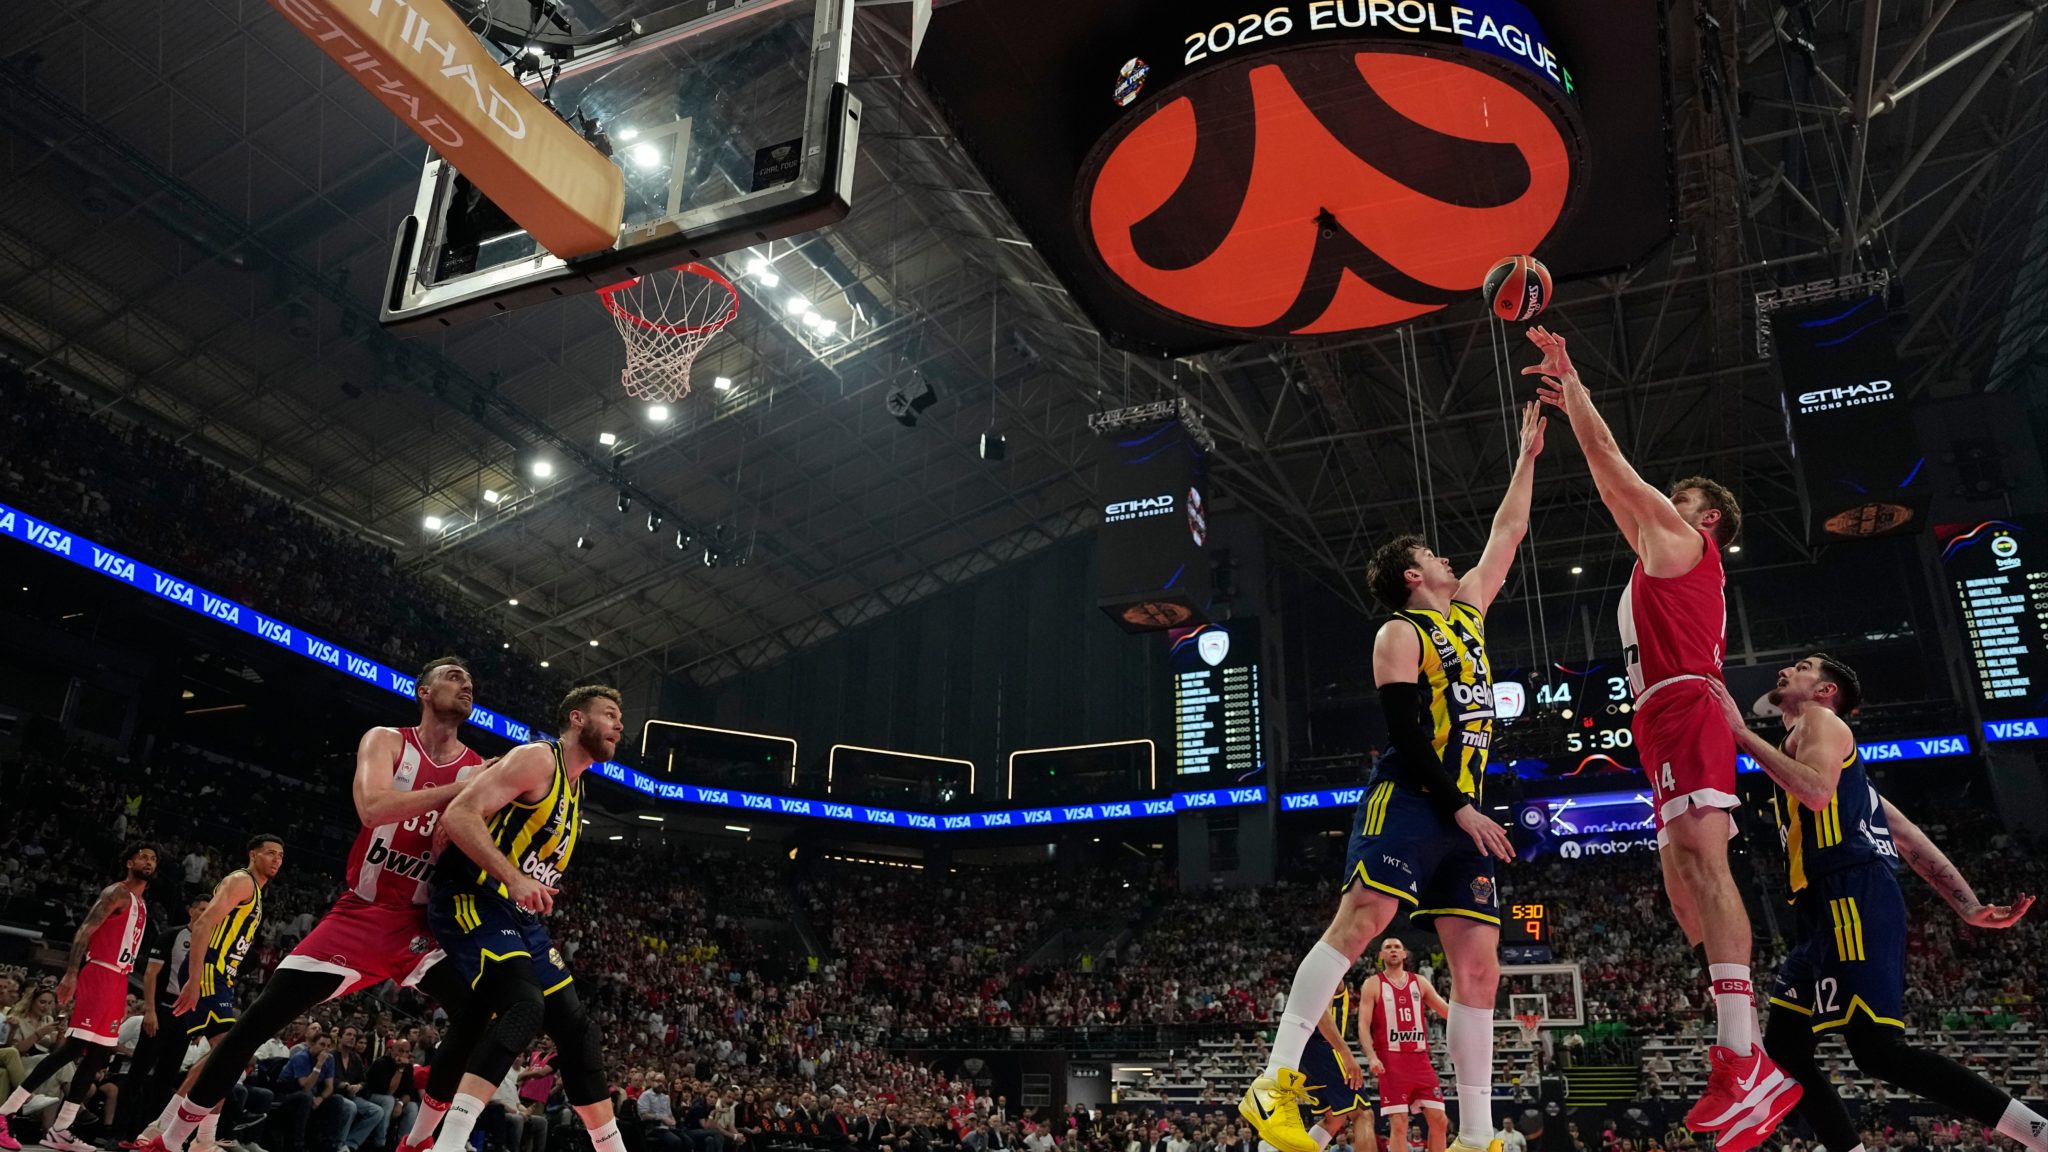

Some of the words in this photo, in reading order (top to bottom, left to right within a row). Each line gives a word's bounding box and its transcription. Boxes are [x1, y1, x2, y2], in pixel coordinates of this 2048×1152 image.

[1185, 7, 1292, 65] 2026
[1309, 0, 1560, 81] EUROLEAGUE
[1798, 380, 1892, 404] ETIHAD
[1801, 401, 1842, 414] BEYOND
[1846, 393, 1895, 407] BORDERS
[1105, 495, 1174, 515] ETIHAD
[1105, 512, 1136, 523] BEYOND
[1138, 506, 1174, 518] BORDERS
[25, 519, 71, 555] VISA
[93, 547, 134, 581] VISA
[154, 573, 193, 605] VISA
[202, 593, 239, 624] VISA
[256, 616, 290, 645] VISA
[307, 637, 339, 665] VISA
[346, 654, 377, 681] VISA
[391, 673, 416, 697] VIS
[1607, 676, 1634, 701] 3
[505, 721, 531, 742] VISA
[1987, 722, 2040, 739] VISA
[1857, 744, 1902, 760] VISA
[1916, 738, 1964, 755] VISA
[604, 762, 625, 781] VISA
[633, 773, 655, 794] VISA
[697, 789, 728, 803] VISA
[741, 794, 772, 809] VISA
[1183, 793, 1216, 806] VISA
[1228, 789, 1262, 802] VISA
[1285, 794, 1318, 808] VISA
[780, 799, 810, 814] VISA
[823, 804, 853, 818] VISA
[1063, 807, 1093, 820] VISA
[1100, 804, 1131, 817] VISA
[1143, 801, 1174, 814] VISA
[865, 810, 895, 823] VISA
[907, 814, 936, 828] VISA
[943, 816, 972, 828] VISA
[982, 813, 1011, 825] VISA
[1022, 810, 1052, 823] VISA
[554, 835, 570, 860] 4
[367, 838, 436, 882] bwi
[1382, 854, 1400, 868] YKT
[1512, 904, 1543, 919] 5:30
[1526, 921, 1540, 940] 9
[1815, 977, 1840, 1014] 12
[1398, 1007, 1411, 1022] 16
[1390, 1028, 1424, 1043] bwin
[595, 1130, 618, 1143] adidas
